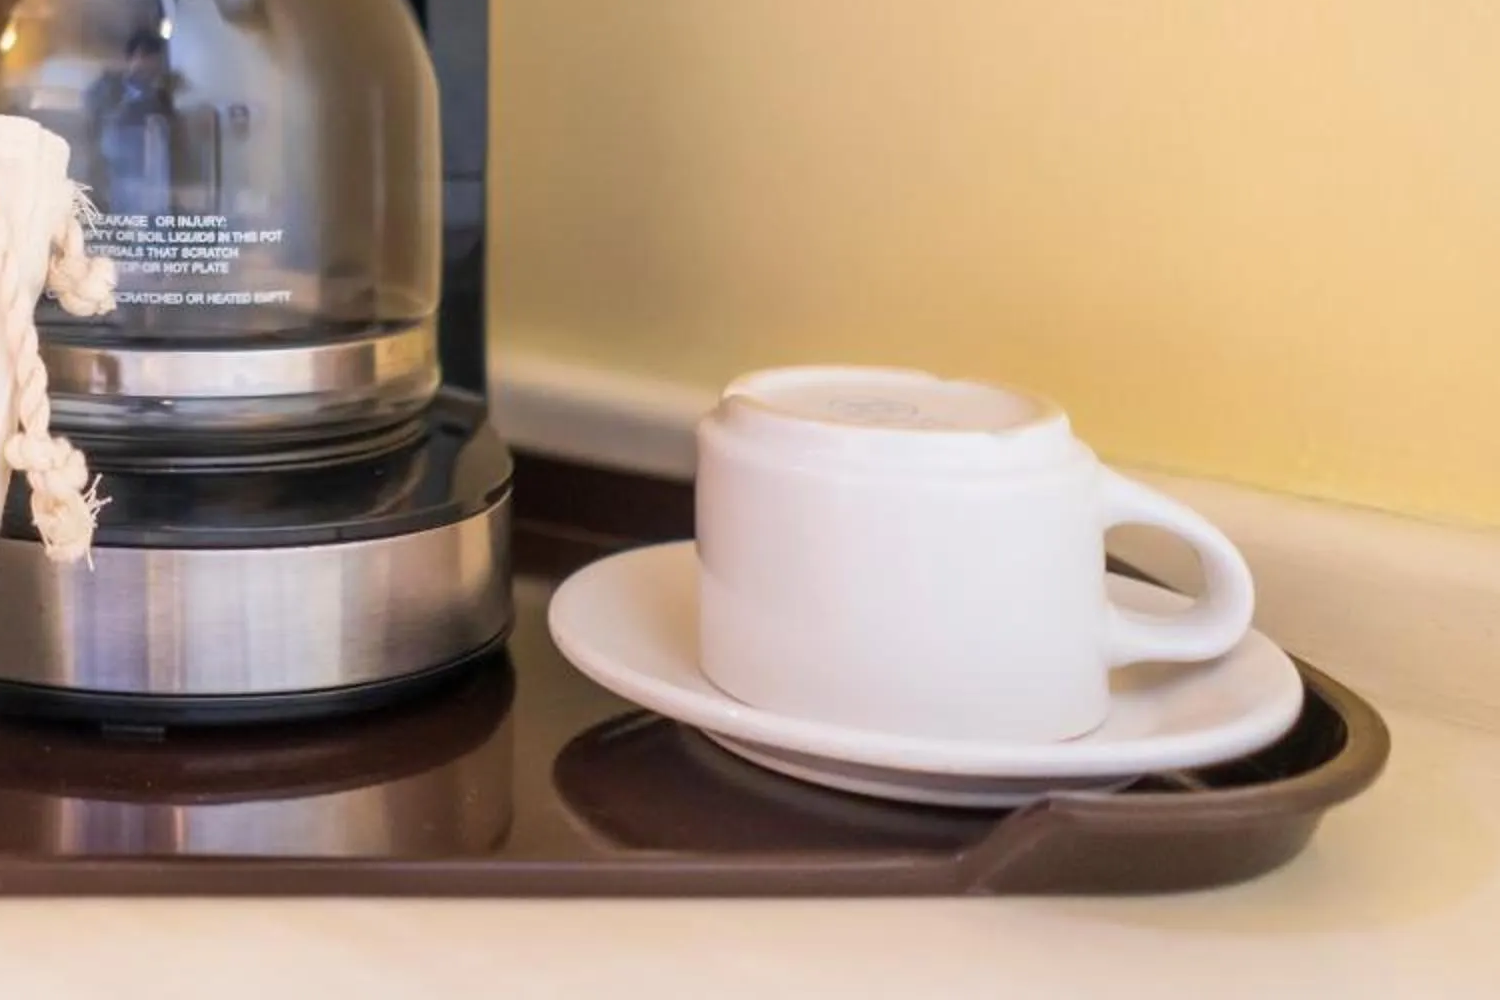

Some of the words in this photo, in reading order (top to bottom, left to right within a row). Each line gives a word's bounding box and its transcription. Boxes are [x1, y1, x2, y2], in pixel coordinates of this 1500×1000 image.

[155, 215, 175, 228] OR
[115, 231, 135, 241] OR
[168, 231, 215, 243] LIQUIDS
[232, 231, 257, 242] THIS
[259, 229, 284, 242] POT
[146, 247, 178, 258] THAT
[181, 247, 239, 259] SCRATCH
[142, 262, 161, 273] OR
[163, 262, 189, 273] HOT
[191, 262, 229, 274] PLATE
[186, 293, 204, 305] OR
[206, 293, 252, 305] HEATED
